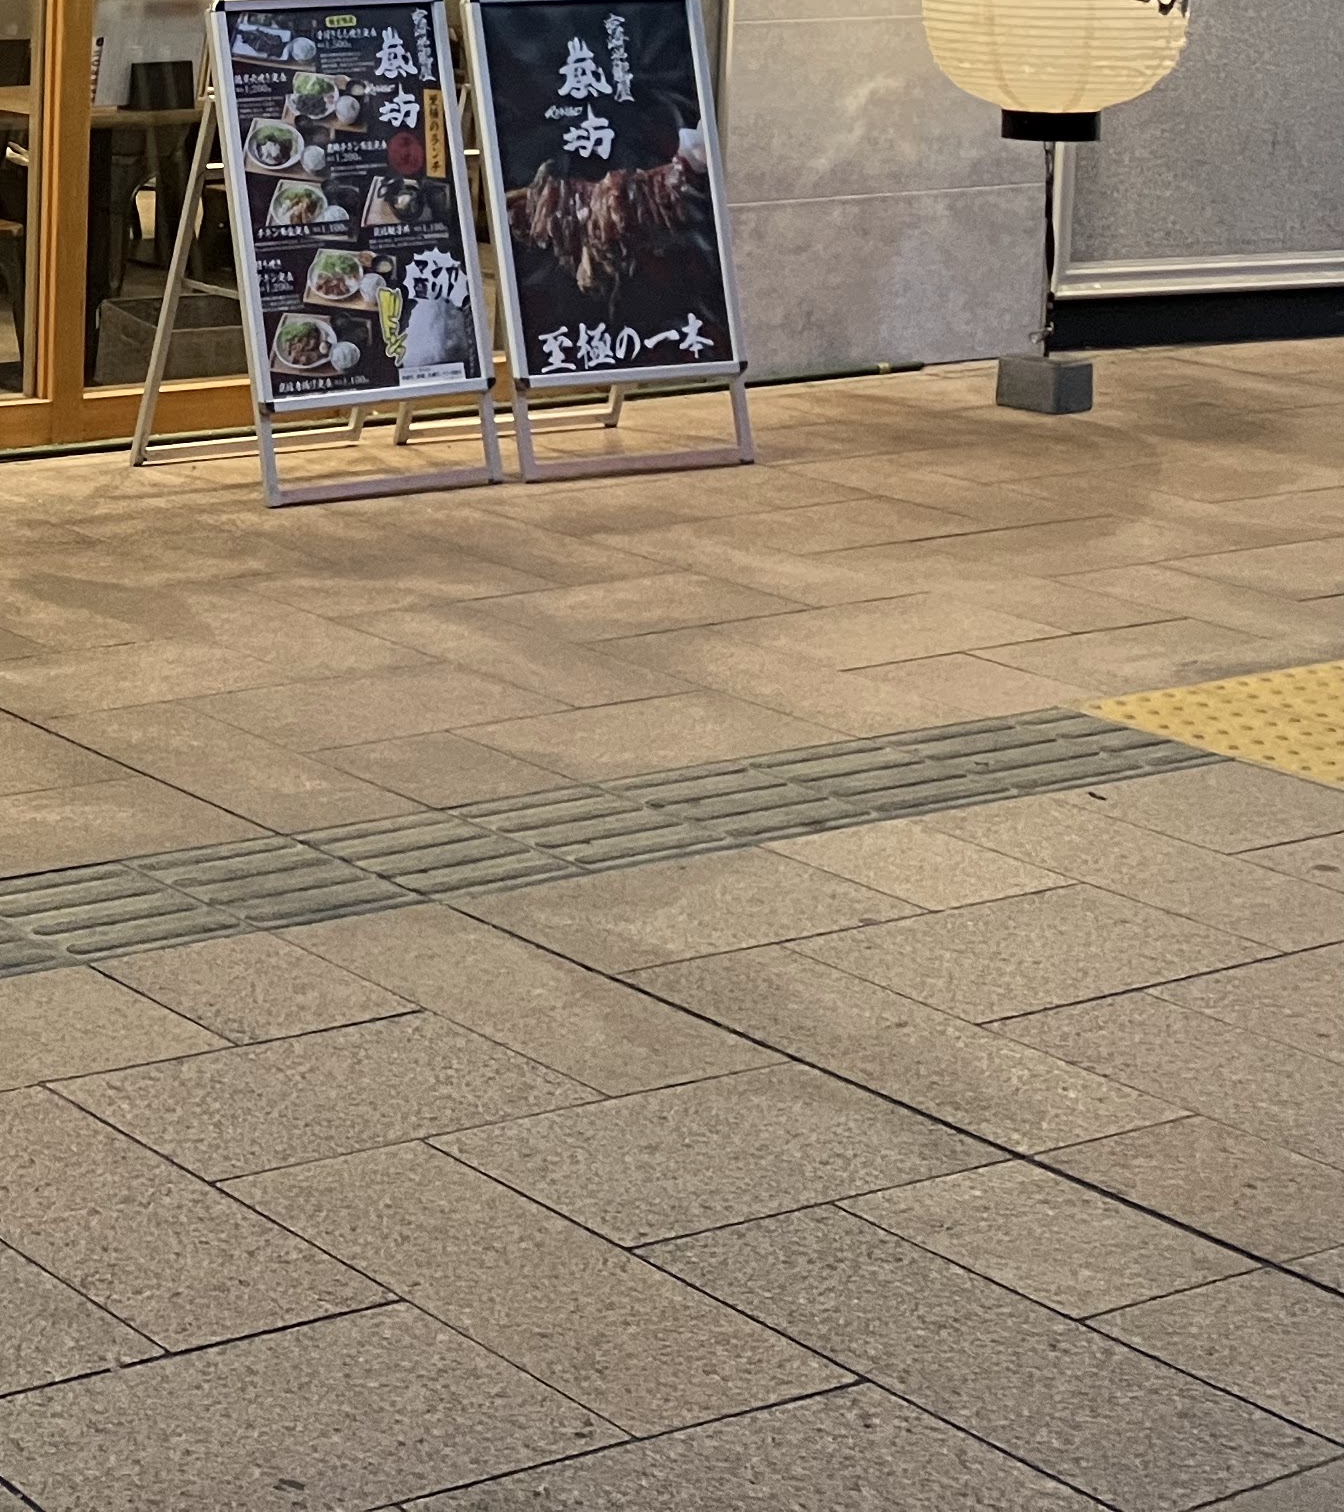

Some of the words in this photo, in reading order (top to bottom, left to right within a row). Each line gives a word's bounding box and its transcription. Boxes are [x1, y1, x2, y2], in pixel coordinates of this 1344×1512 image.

[539, 313, 714, 374] 至極の一本
